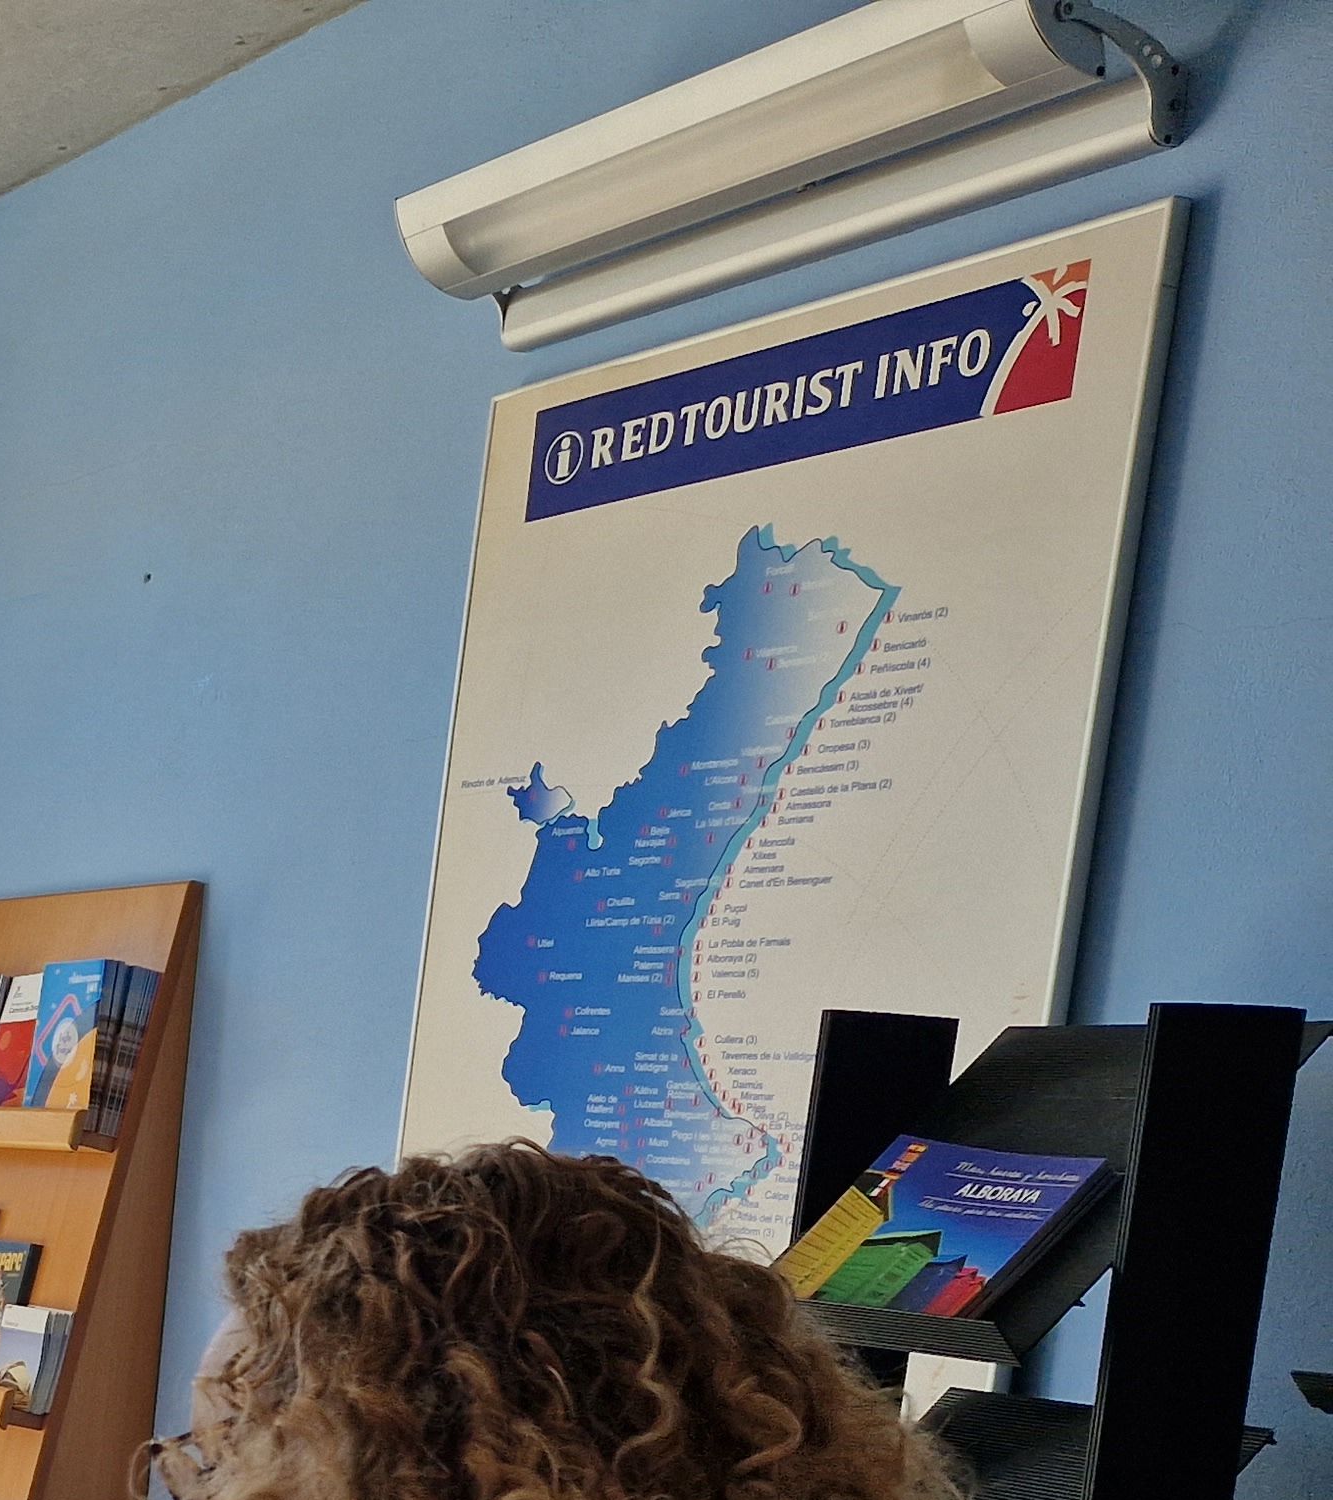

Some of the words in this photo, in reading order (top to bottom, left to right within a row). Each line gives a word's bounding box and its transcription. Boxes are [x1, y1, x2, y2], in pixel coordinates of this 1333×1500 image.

[872, 329, 991, 397] INFO
[879, 688, 891, 697] de
[818, 743, 856, 754] Oropesa
[827, 784, 839, 793] de
[746, 938, 757, 946] de
[707, 955, 743, 964] Alboraya
[954, 1183, 1041, 1203] ALBORAYA
